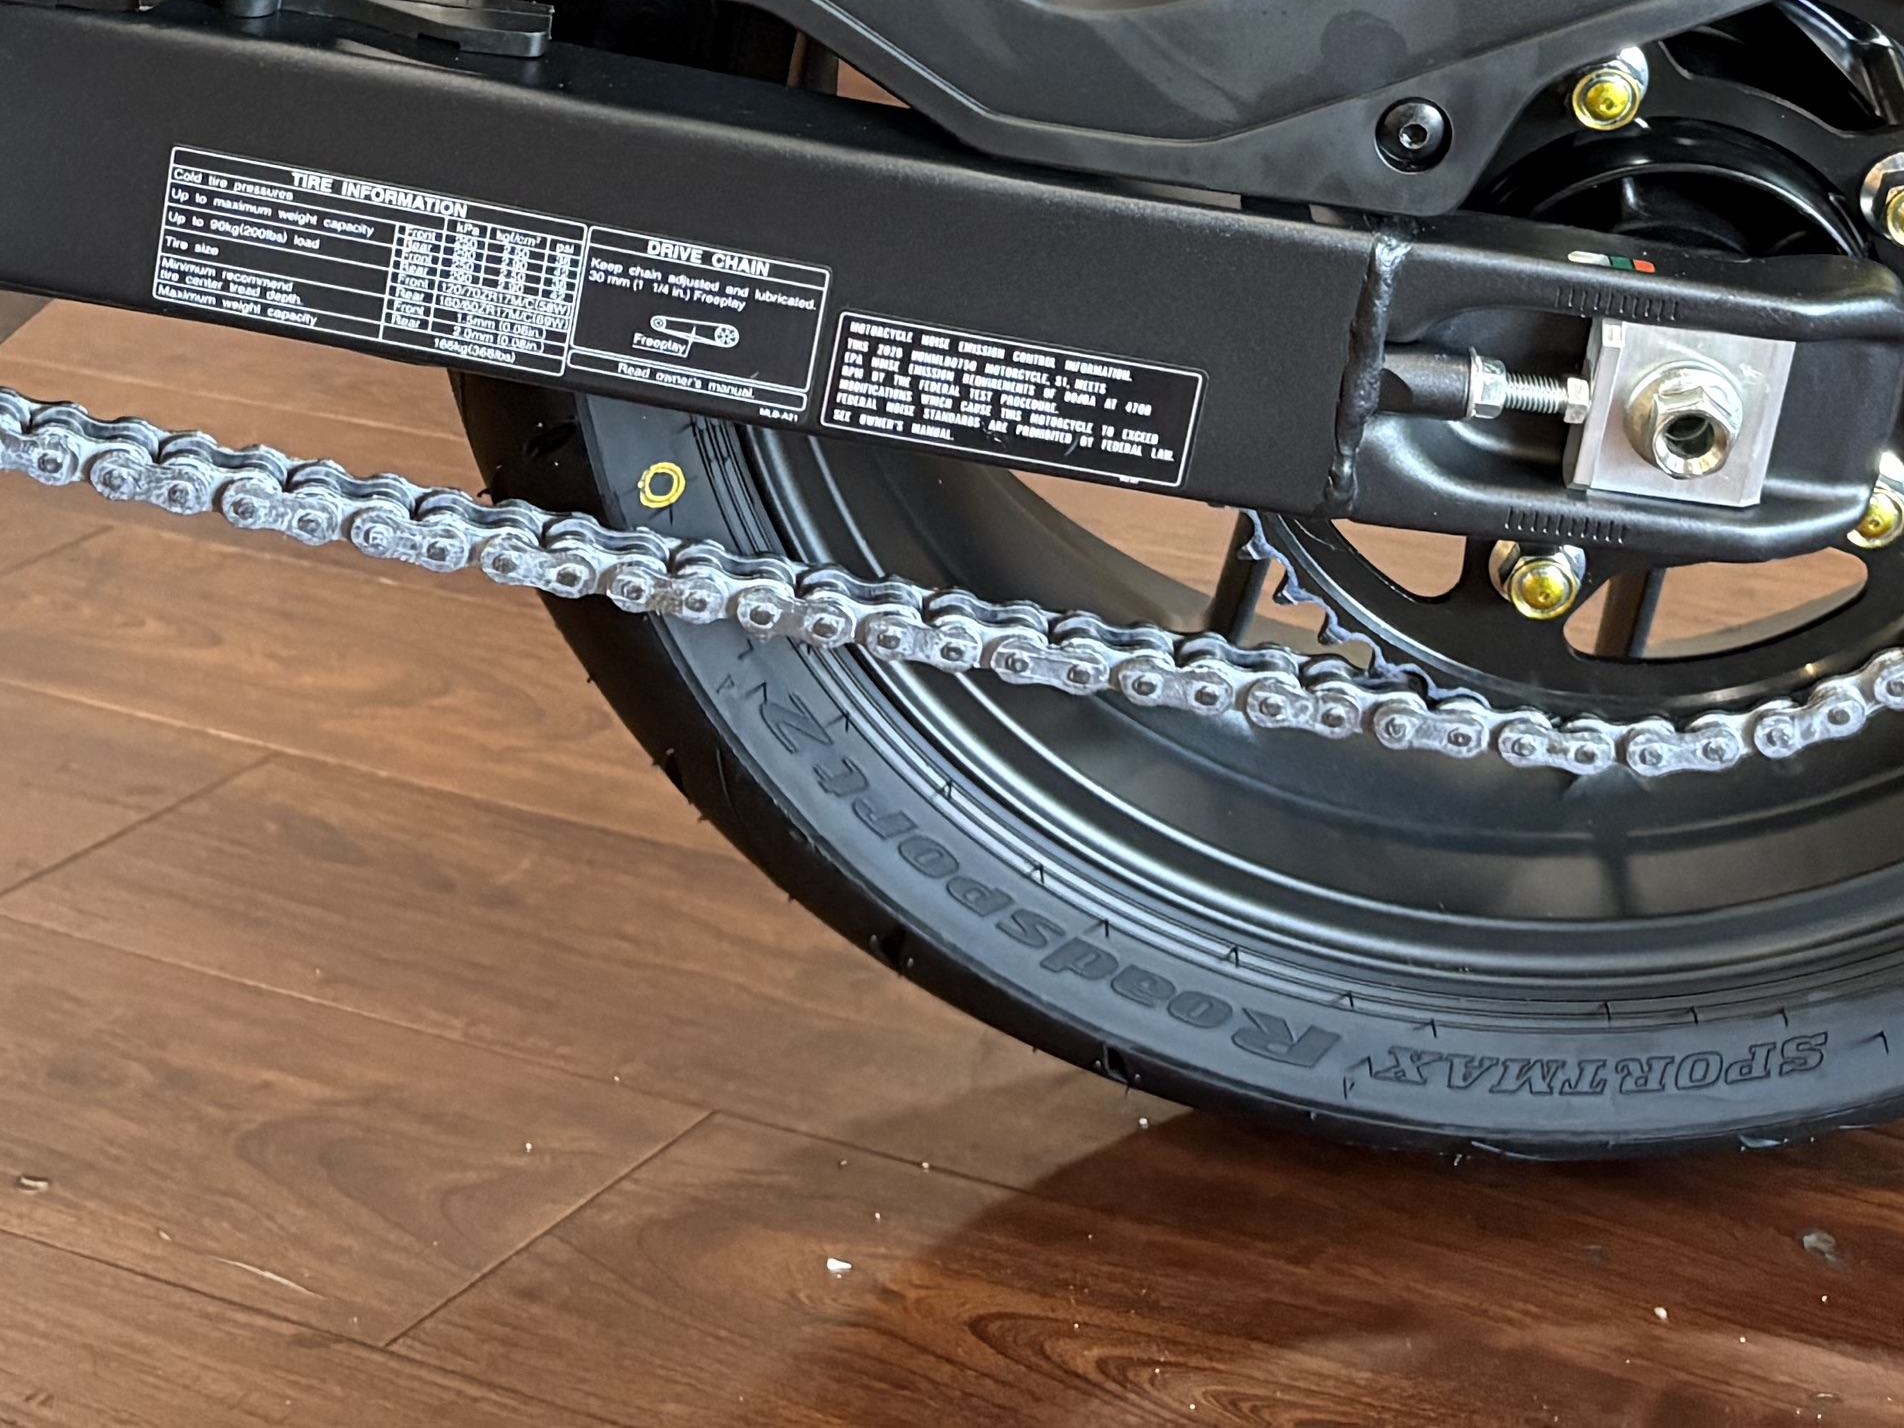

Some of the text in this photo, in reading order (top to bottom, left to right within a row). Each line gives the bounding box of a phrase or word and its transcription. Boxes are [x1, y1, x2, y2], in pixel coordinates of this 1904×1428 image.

[172, 168, 294, 202] Cold tire pressures
[290, 171, 467, 218] TIRE INFORMATION
[167, 211, 186, 226] Up
[192, 215, 204, 227] to
[293, 235, 320, 249] load
[170, 187, 374, 239] Up to maximum weight capacity
[164, 235, 219, 256] Tire size
[455, 221, 480, 236] kPa
[555, 241, 575, 254] psi
[161, 257, 293, 292] Minimum recommend
[646, 240, 770, 276] DRIVE CHAIN
[159, 269, 179, 282] tire
[185, 274, 223, 290] center
[228, 282, 260, 297] tread
[395, 287, 424, 302] Rear
[397, 273, 428, 289] Front
[588, 270, 604, 283] 30
[607, 275, 630, 288] mm
[651, 282, 669, 295] 1/4
[692, 290, 746, 312] Freeplay
[589, 257, 817, 310] Keep chain adjusted and lubricated.
[157, 284, 317, 327] Maximum weight capacity
[391, 314, 420, 329] Rear
[393, 300, 424, 316] Front
[632, 332, 686, 354] Freeplay
[849, 321, 1134, 382] MOTORCYCLE NOISE EMISSION CONTROL INFORMATION.
[617, 362, 755, 398] Read owner's manual.
[843, 351, 864, 365] EPA
[870, 356, 900, 372] NOISE
[907, 363, 955, 381] EMISSION
[961, 372, 1036, 396] REQUIREMENTS
[1042, 386, 1056, 399] OF
[1103, 397, 1117, 410] AT
[846, 337, 870, 352] THIS
[1073, 378, 1107, 394] MEETS
[840, 365, 1060, 414] RPM BY THE FEDERAL TEST PROCEDURE.
[832, 409, 956, 440] SEE OWNER'S MANUAL.
[835, 392, 878, 409] FEDERAL
[885, 401, 915, 416] NOISE
[922, 407, 981, 428] STANDARDS
[988, 419, 1008, 432] ARE
[1015, 424, 1073, 444] PROHIBITED
[1078, 435, 1094, 448] BY
[1100, 439, 1144, 456] FEDERAL
[838, 378, 1159, 445] MODIFICATIONS WHICH CAUSE THIS MOTORCYCLE TO EXCEED
[759, 693, 1342, 1069] Roadsport 2
[1369, 1031, 1829, 1099] SPORTMAX
